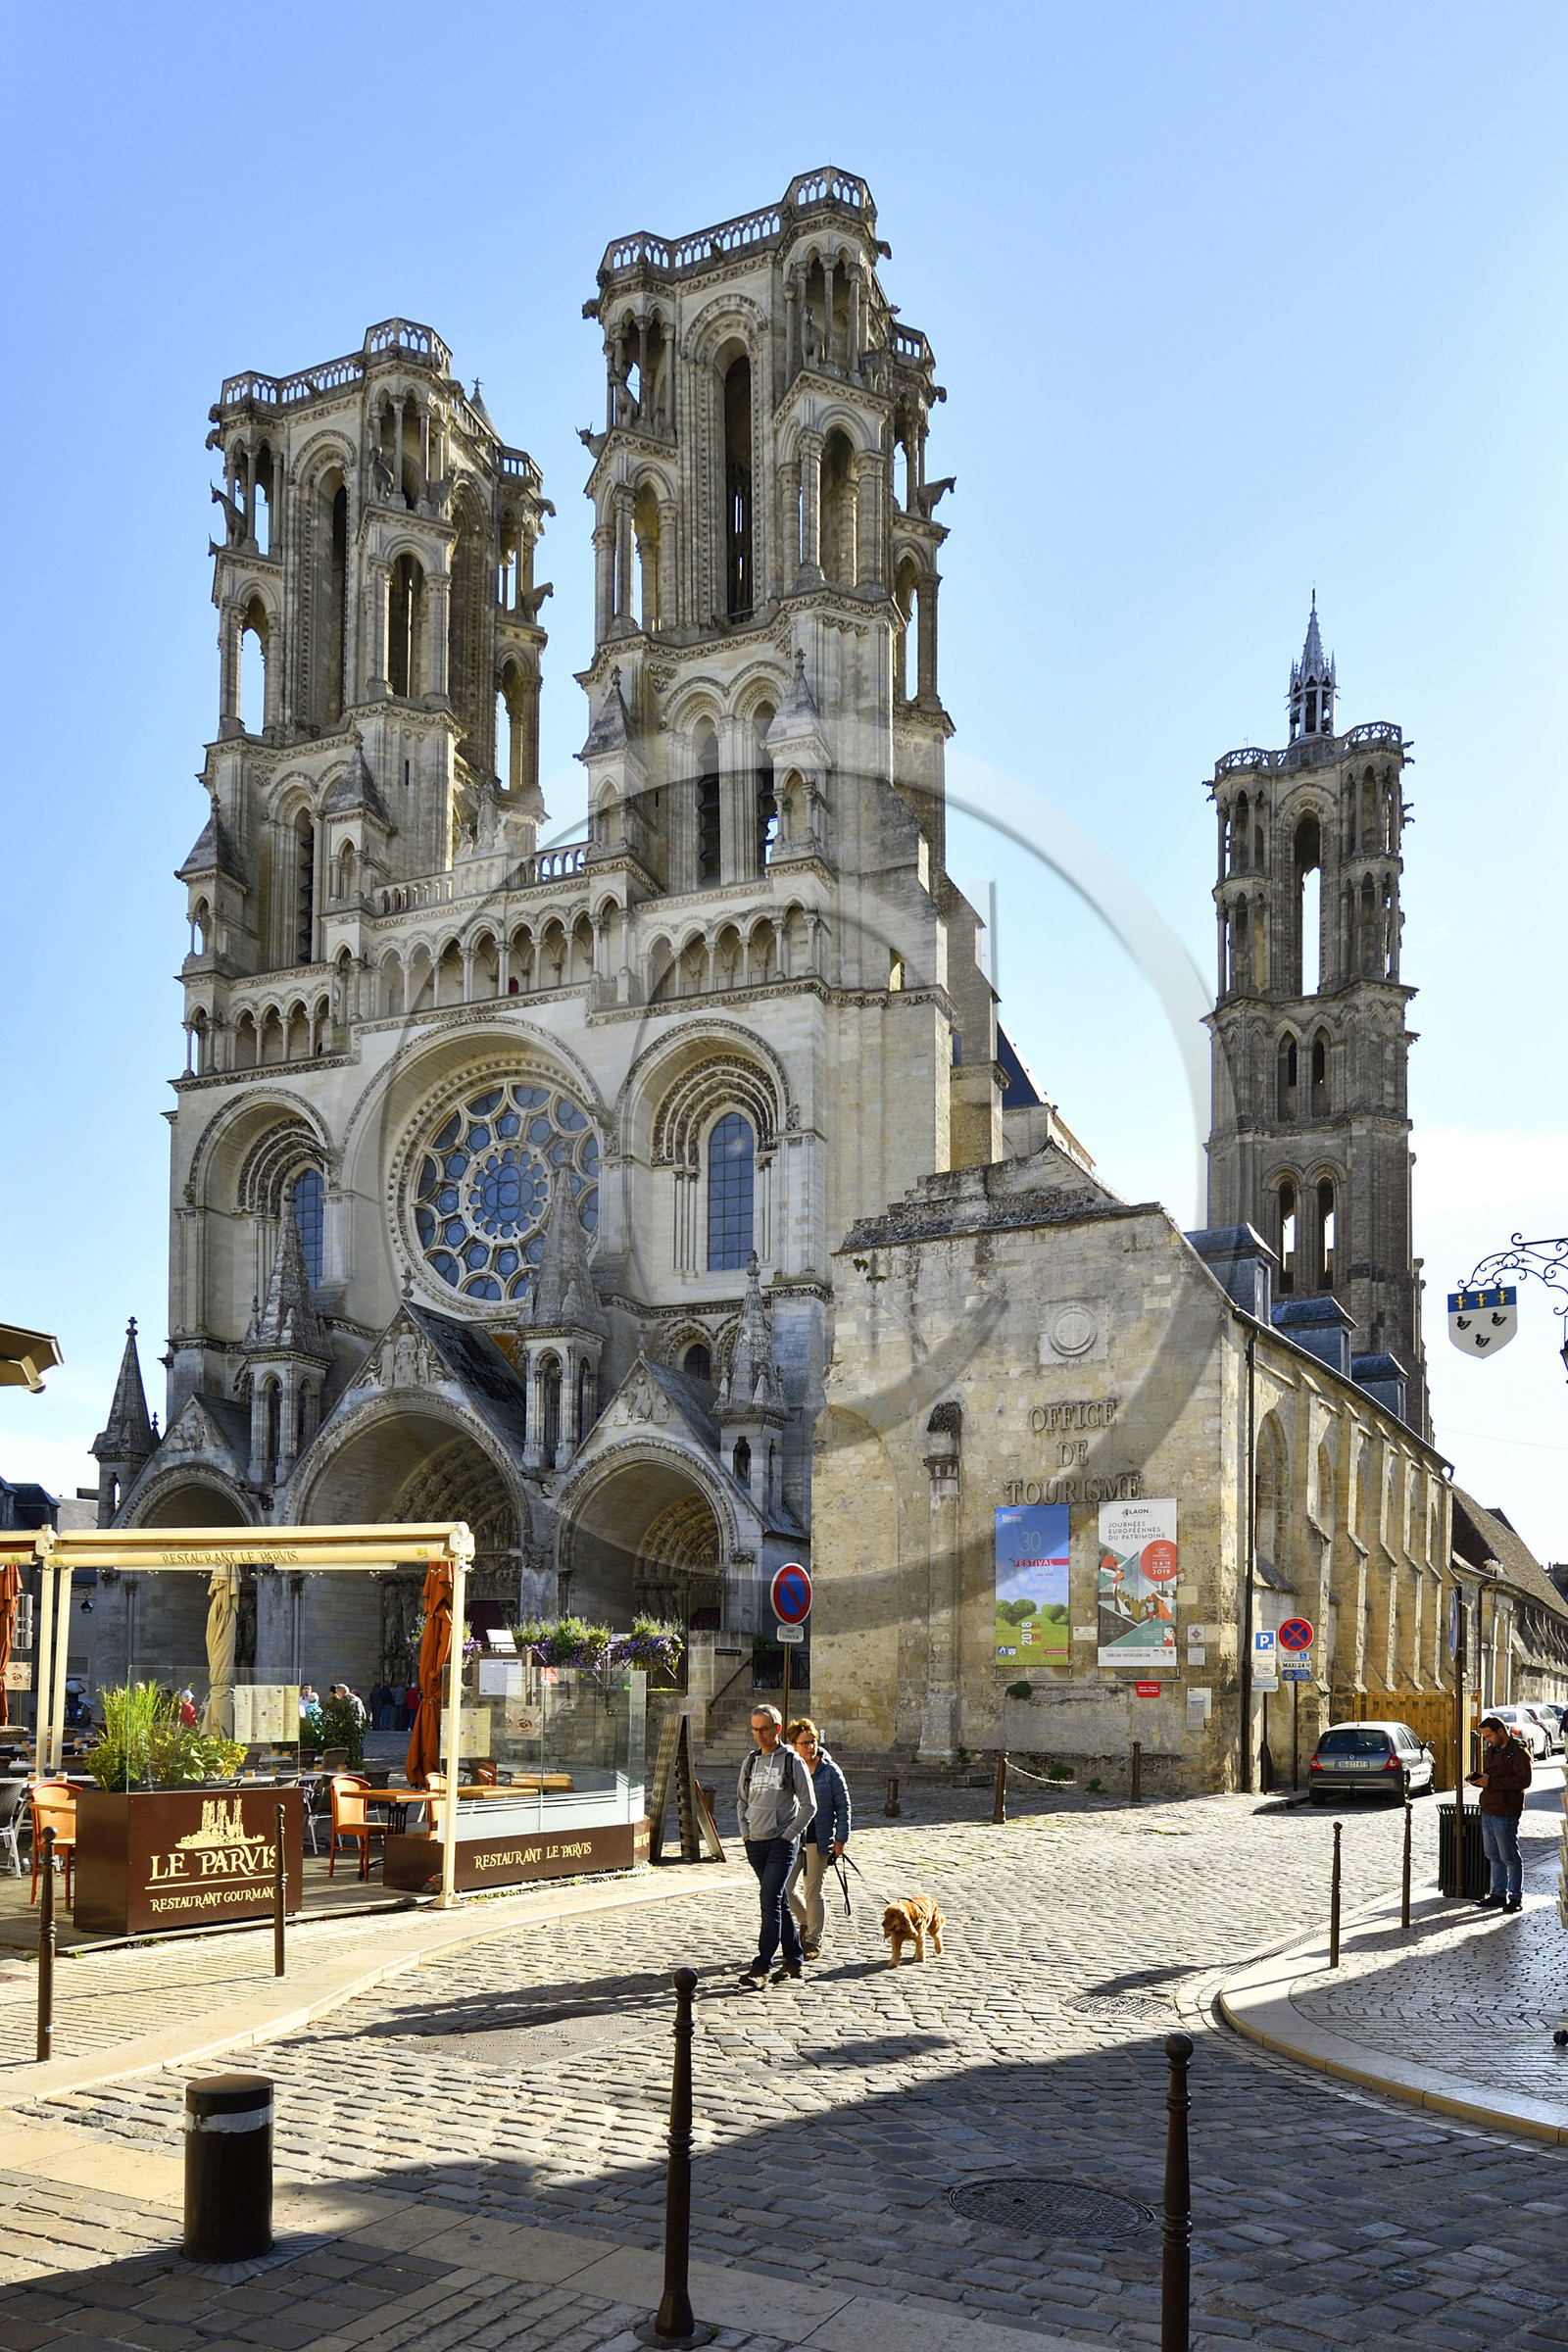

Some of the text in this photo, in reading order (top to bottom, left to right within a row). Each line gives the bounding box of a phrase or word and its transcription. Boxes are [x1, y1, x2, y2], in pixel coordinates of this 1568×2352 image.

[1029, 1401, 1117, 1433] OFFICE
[1056, 1440, 1089, 1467] DE
[1006, 1476, 1142, 1505] TOURISME
[160, 1549, 299, 1565] RESTAURANT LE PARVIS
[1021, 1621, 1032, 1645] 2018
[149, 1852, 190, 1882] LE
[473, 1841, 592, 1871] RESTAURANT LE PARVIS
[150, 1886, 276, 1913] RESTAURANT GOURMAN
